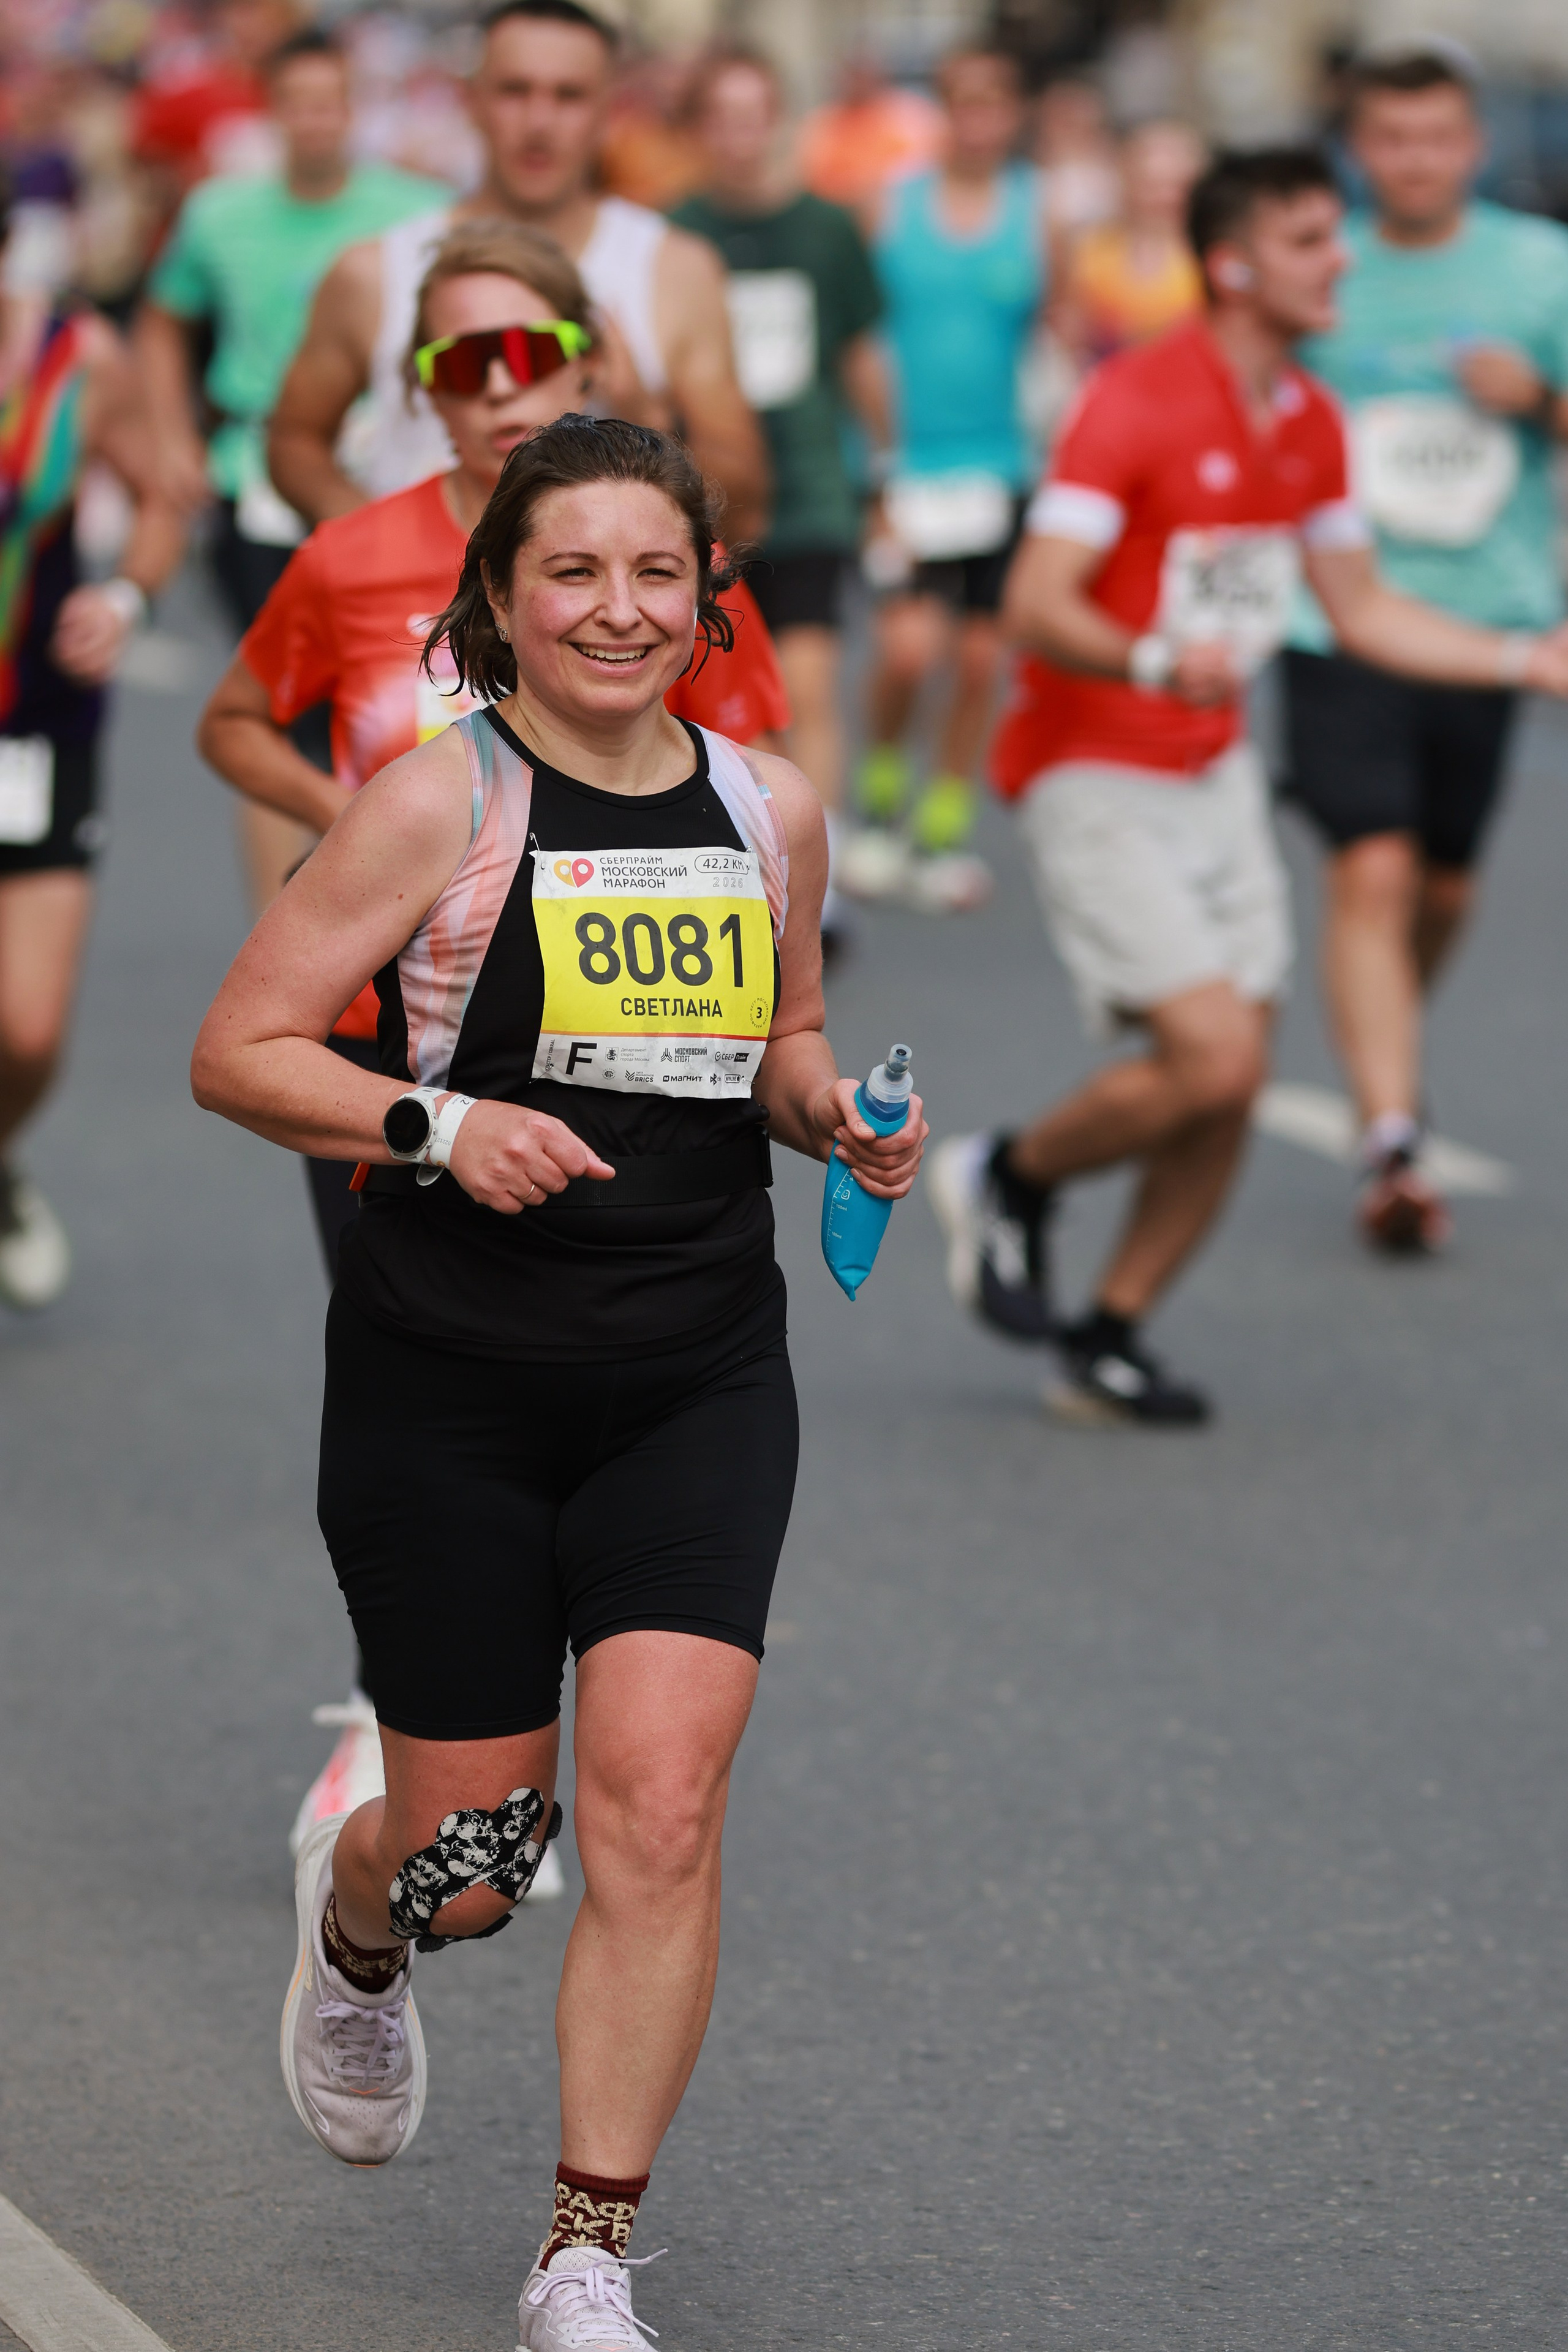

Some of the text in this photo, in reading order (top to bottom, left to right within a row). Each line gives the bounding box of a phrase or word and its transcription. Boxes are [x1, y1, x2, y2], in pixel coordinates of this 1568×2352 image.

[600, 855, 663, 865] СБЕРПРАЙМ
[703, 858, 744, 870] 42,2 КМ
[601, 865, 687, 876] МОСКОВСКИЙ
[603, 878, 666, 888] МАРАФОН
[712, 876, 744, 888] 2026
[575, 912, 744, 988] 8081
[620, 997, 723, 1018] СВЕТЛАНА
[756, 1006, 763, 1019] 3
[674, 1047, 707, 1055] МОСКОВСКИЙ
[565, 1042, 597, 1076] F
